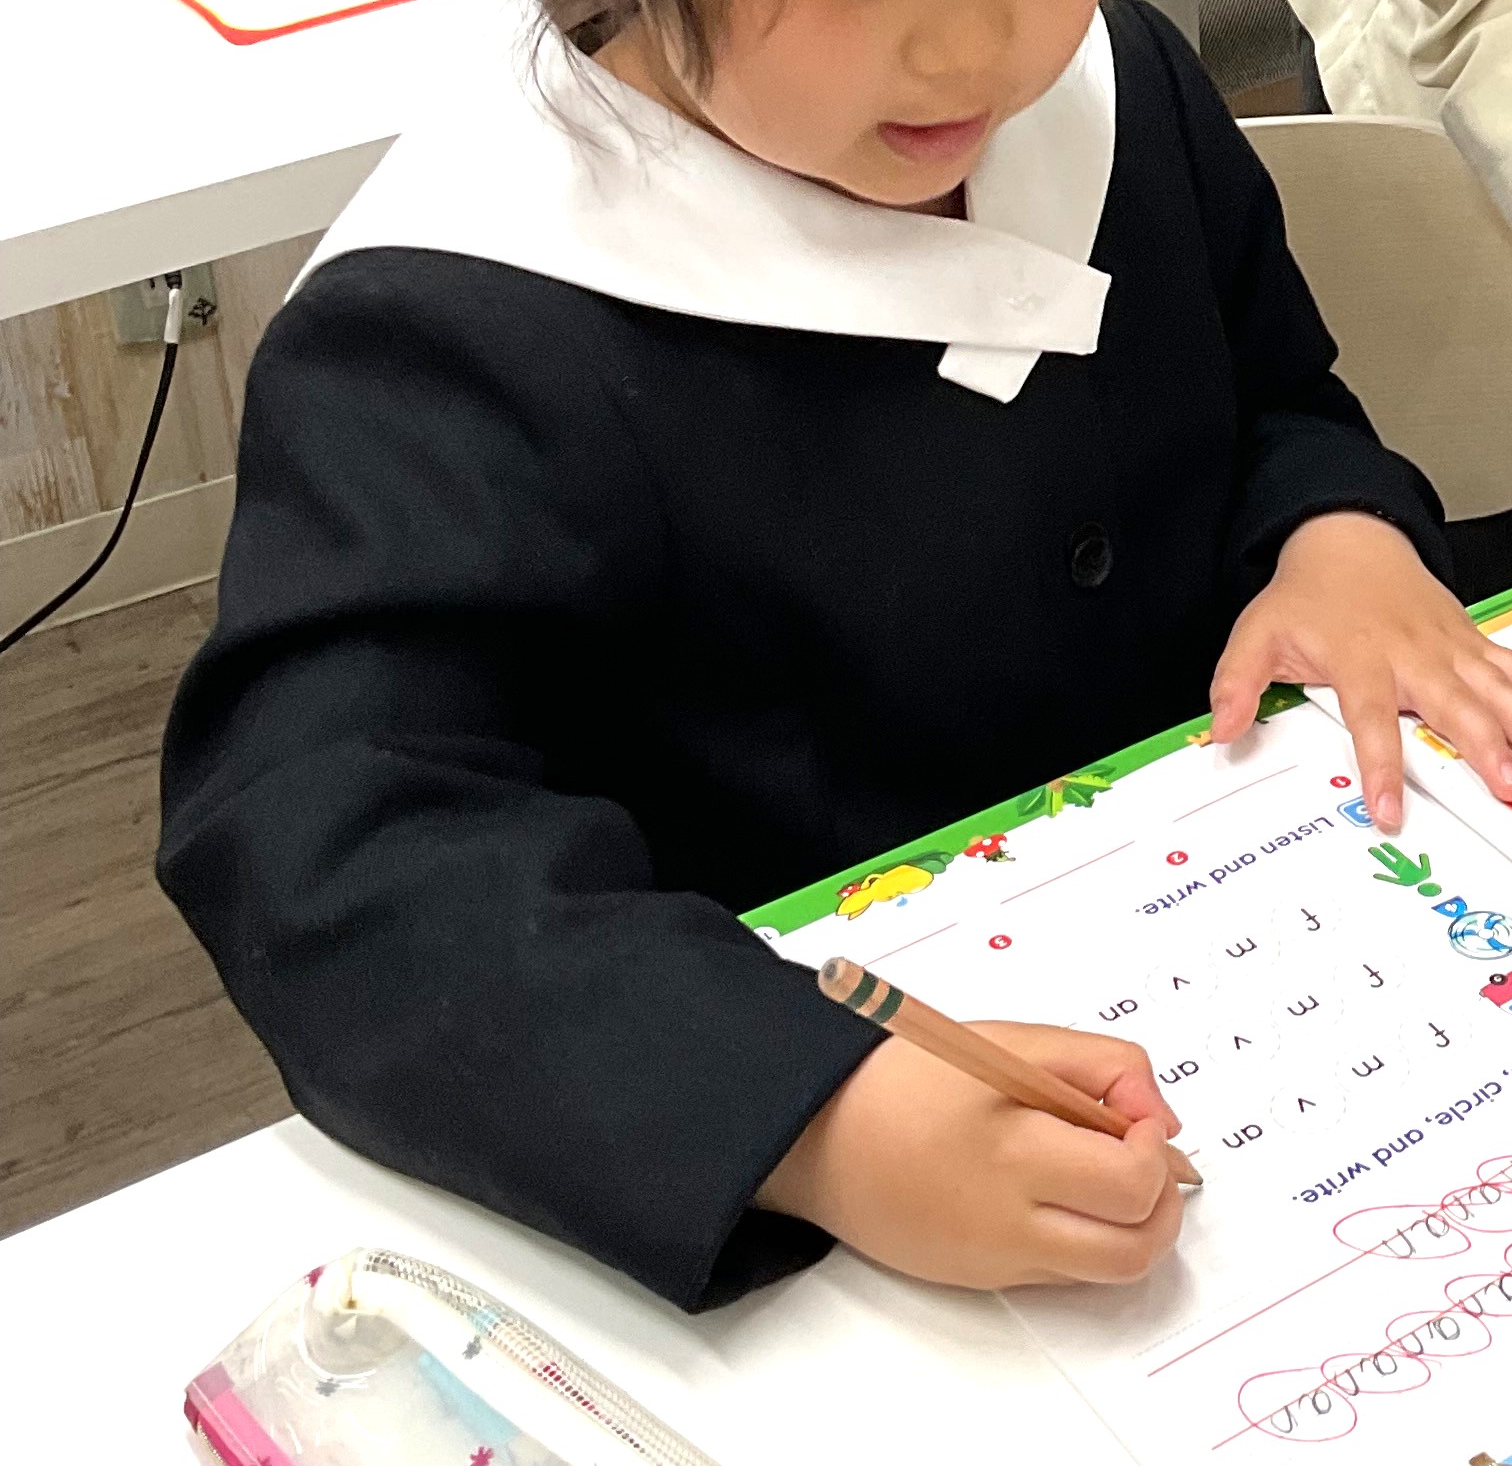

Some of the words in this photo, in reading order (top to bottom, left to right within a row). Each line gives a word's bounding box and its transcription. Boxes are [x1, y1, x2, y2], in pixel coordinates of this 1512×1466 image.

[1260, 817, 1334, 854] Listen
[1209, 853, 1257, 884] and
[1135, 881, 1207, 914] write.
[1226, 938, 1257, 957] m
[1099, 999, 1138, 1021] an
[1287, 995, 1319, 1016] m
[1159, 1060, 1199, 1083] an
[1352, 1055, 1384, 1077] m
[1425, 1082, 1502, 1125] circle,
[1222, 1124, 1263, 1148] an
[1372, 1129, 1424, 1166] and
[1292, 1162, 1370, 1203] write.
